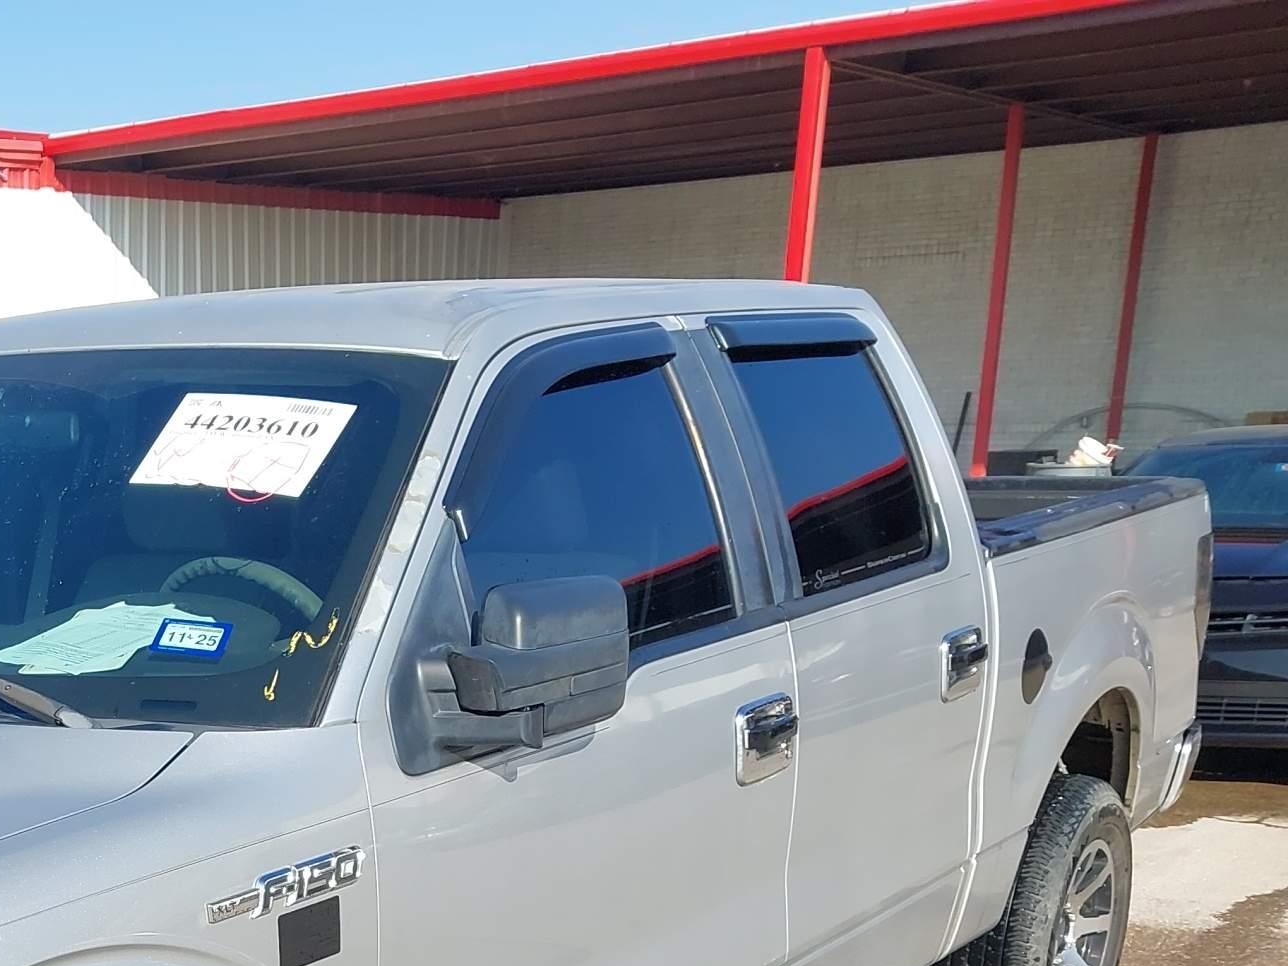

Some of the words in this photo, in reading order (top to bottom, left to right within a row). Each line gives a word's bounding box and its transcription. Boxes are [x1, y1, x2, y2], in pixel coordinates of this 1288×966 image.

[184, 413, 319, 439] 44203610
[168, 631, 185, 644] 11
[196, 633, 220, 647] 25
